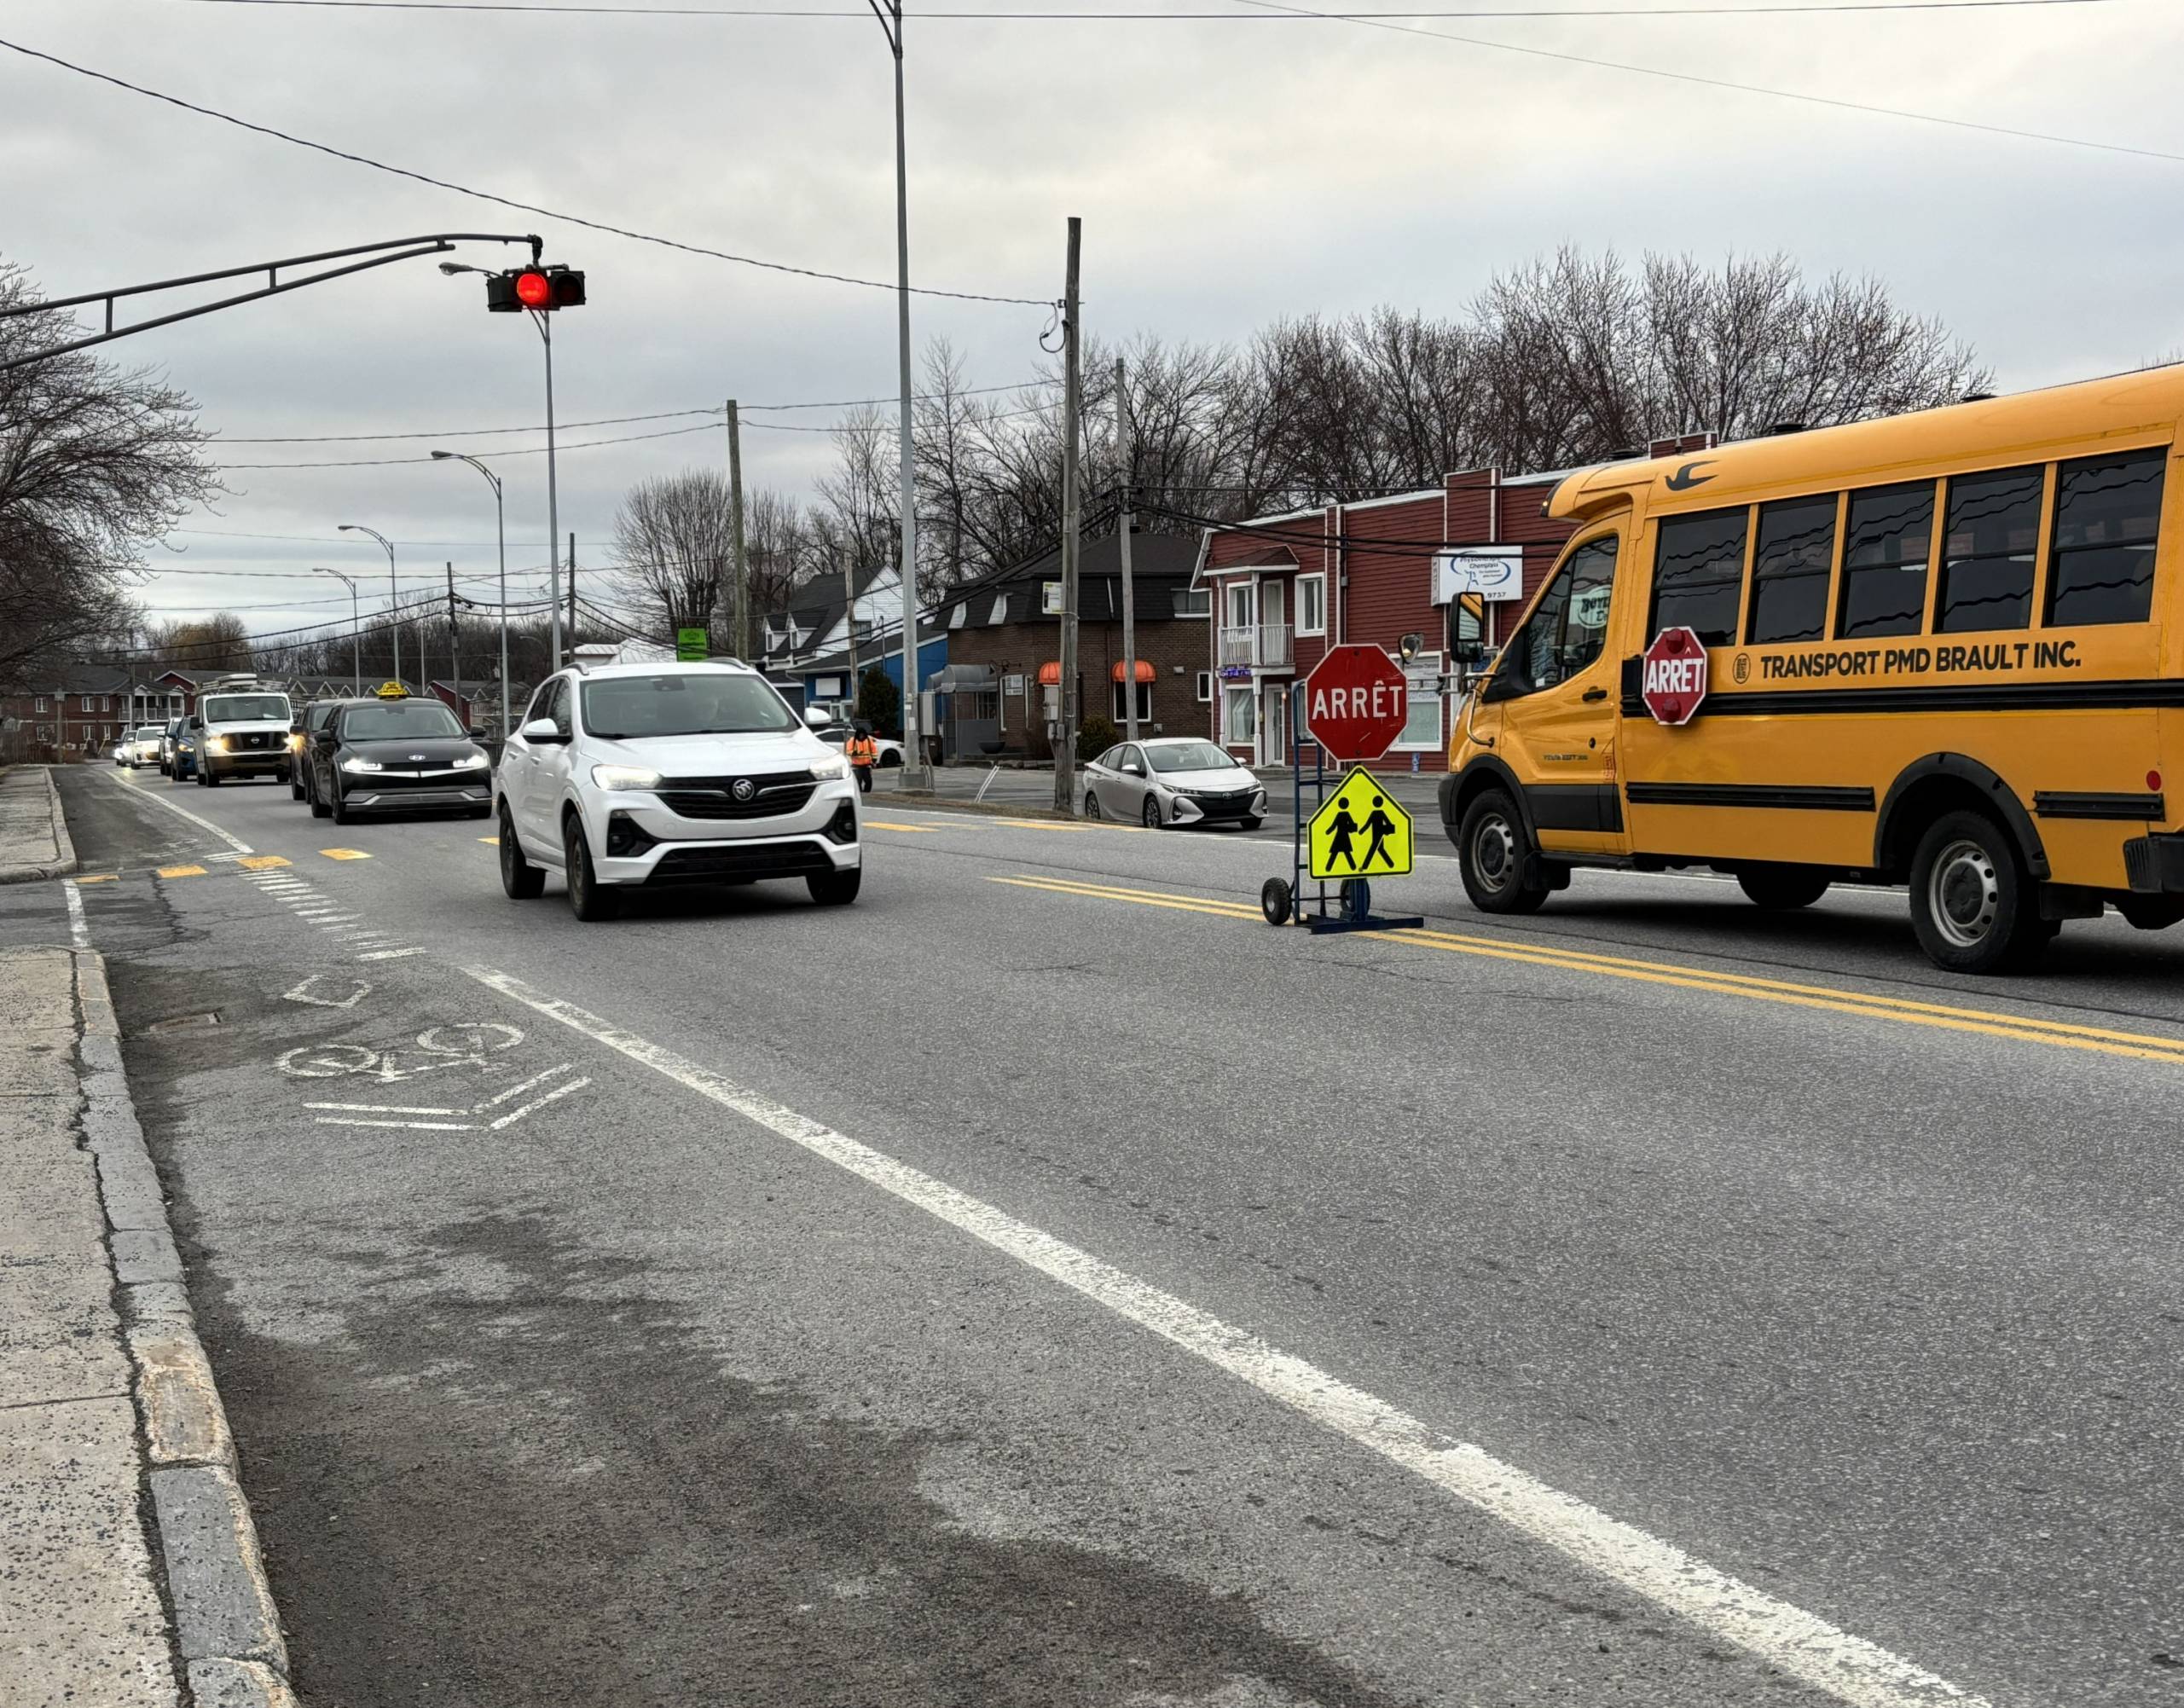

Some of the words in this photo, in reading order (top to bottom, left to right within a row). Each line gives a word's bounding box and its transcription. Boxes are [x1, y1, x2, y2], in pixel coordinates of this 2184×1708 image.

[1760, 650, 1880, 679] TRANSPORT
[1884, 648, 1931, 674] PMD
[1936, 643, 2030, 672] BRAULT
[2033, 640, 2081, 669] INC.
[1312, 680, 1403, 720] ARRÊT
